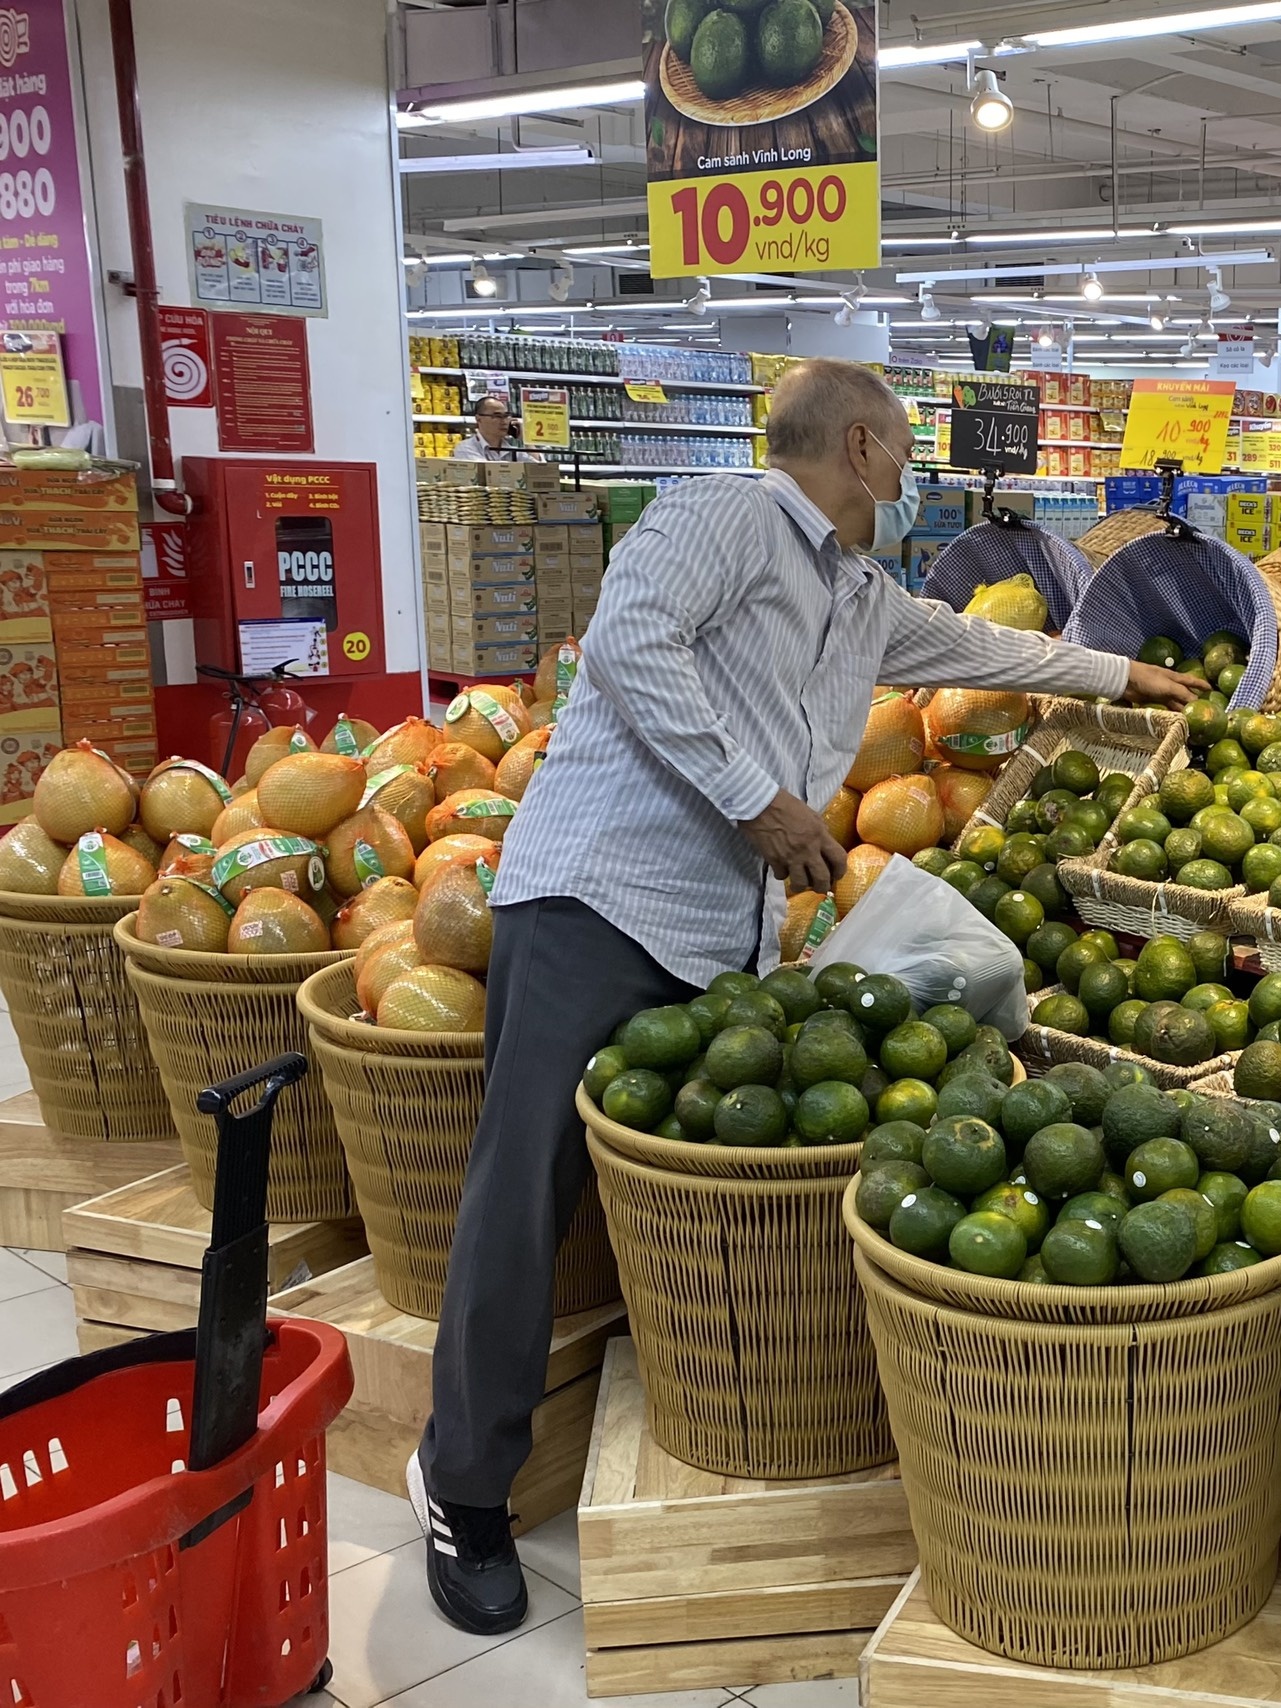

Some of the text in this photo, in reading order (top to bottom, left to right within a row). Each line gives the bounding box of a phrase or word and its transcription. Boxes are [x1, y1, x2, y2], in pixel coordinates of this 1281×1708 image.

[697, 156, 722, 170] Cam
[752, 148, 778, 164] Vĩnh
[782, 147, 811, 163] Long
[671, 174, 847, 266] 10.900
[755, 229, 830, 263] vnd/kg
[1157, 382, 1210, 392] KHUYẾN MÃI
[265, 473, 331, 485] Vật dụng PCCC
[278, 551, 333, 582] PCCC
[280, 585, 297, 598] FIRE
[346, 639, 367, 654] 20
